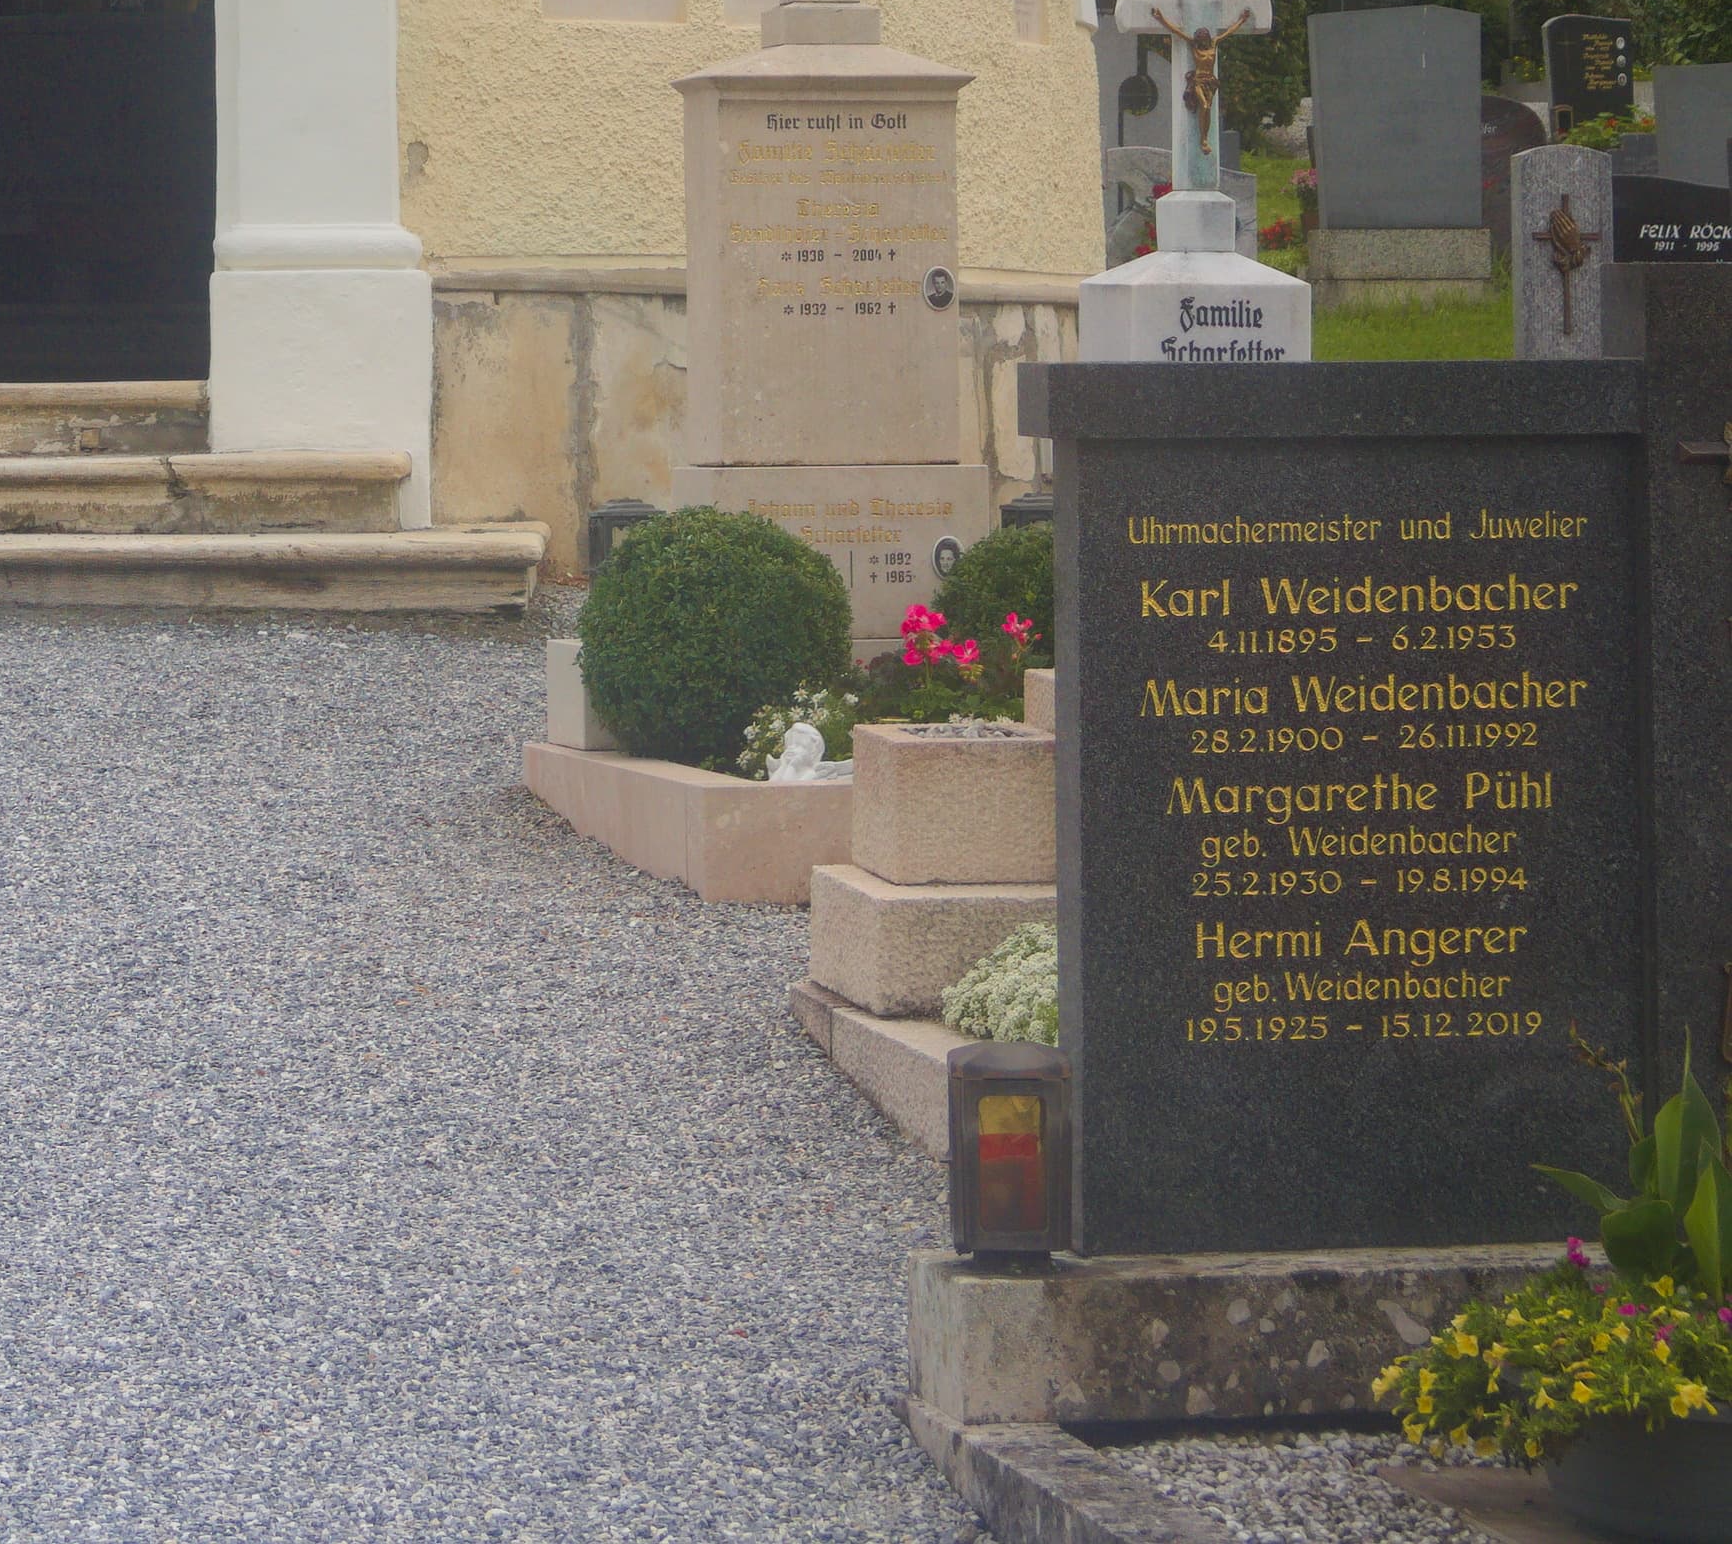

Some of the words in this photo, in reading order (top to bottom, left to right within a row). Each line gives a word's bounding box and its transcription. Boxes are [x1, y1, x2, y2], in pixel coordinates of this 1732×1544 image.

[766, 113, 801, 132] Hier
[806, 113, 842, 133] ruht
[847, 113, 864, 130] in
[870, 112, 907, 130] Gott
[737, 138, 813, 166] Familie
[820, 138, 937, 164] Scharfetter
[796, 198, 880, 219] Theresia
[847, 222, 949, 245] Scharfetter
[1639, 223, 1682, 239] FELIX
[852, 249, 883, 262] 2004
[1654, 241, 1676, 251] 1911
[1696, 241, 1721, 252] 1995
[756, 276, 805, 297] Hans
[819, 275, 921, 298] Scharfetter
[800, 303, 827, 316] 1932
[854, 302, 882, 316] 1962
[1180, 296, 1263, 333] Familie
[1161, 336, 1285, 362] Scharfetter
[747, 497, 817, 520] Johann
[824, 497, 860, 518] und
[868, 496, 954, 519] Theresia
[799, 524, 902, 546] Scharfetter
[1128, 514, 1381, 545] Uhrmachermeister
[1399, 512, 1452, 541] und
[1470, 509, 1587, 539] Juwelier
[884, 552, 912, 566] 1892
[1141, 579, 1231, 618] Karl
[1260, 574, 1578, 615] Weidenbacher
[1208, 628, 1338, 654] 4.11.1895
[1391, 624, 1517, 652] 6.2.1953
[1141, 679, 1269, 717] Maria
[1292, 671, 1588, 714] Weidenbacher
[1192, 726, 1344, 755] 28.2.1900
[1399, 722, 1538, 750] 26.11.1992
[1168, 773, 1438, 824] Margarethe
[1465, 771, 1553, 810] Pühl
[1201, 829, 1268, 867] geb.
[1288, 824, 1517, 858] Weidenbacher
[1193, 869, 1343, 897] 25.2.1930
[1397, 865, 1528, 894] 19.8.1994
[1196, 921, 1323, 960] Hermi
[1343, 918, 1528, 968] Angerer
[1213, 974, 1278, 1014] geb.
[1284, 970, 1512, 1002] Weidenbacher
[1186, 1014, 1328, 1042] 19.5.1925
[1381, 1011, 1543, 1039] 15.12.2019
